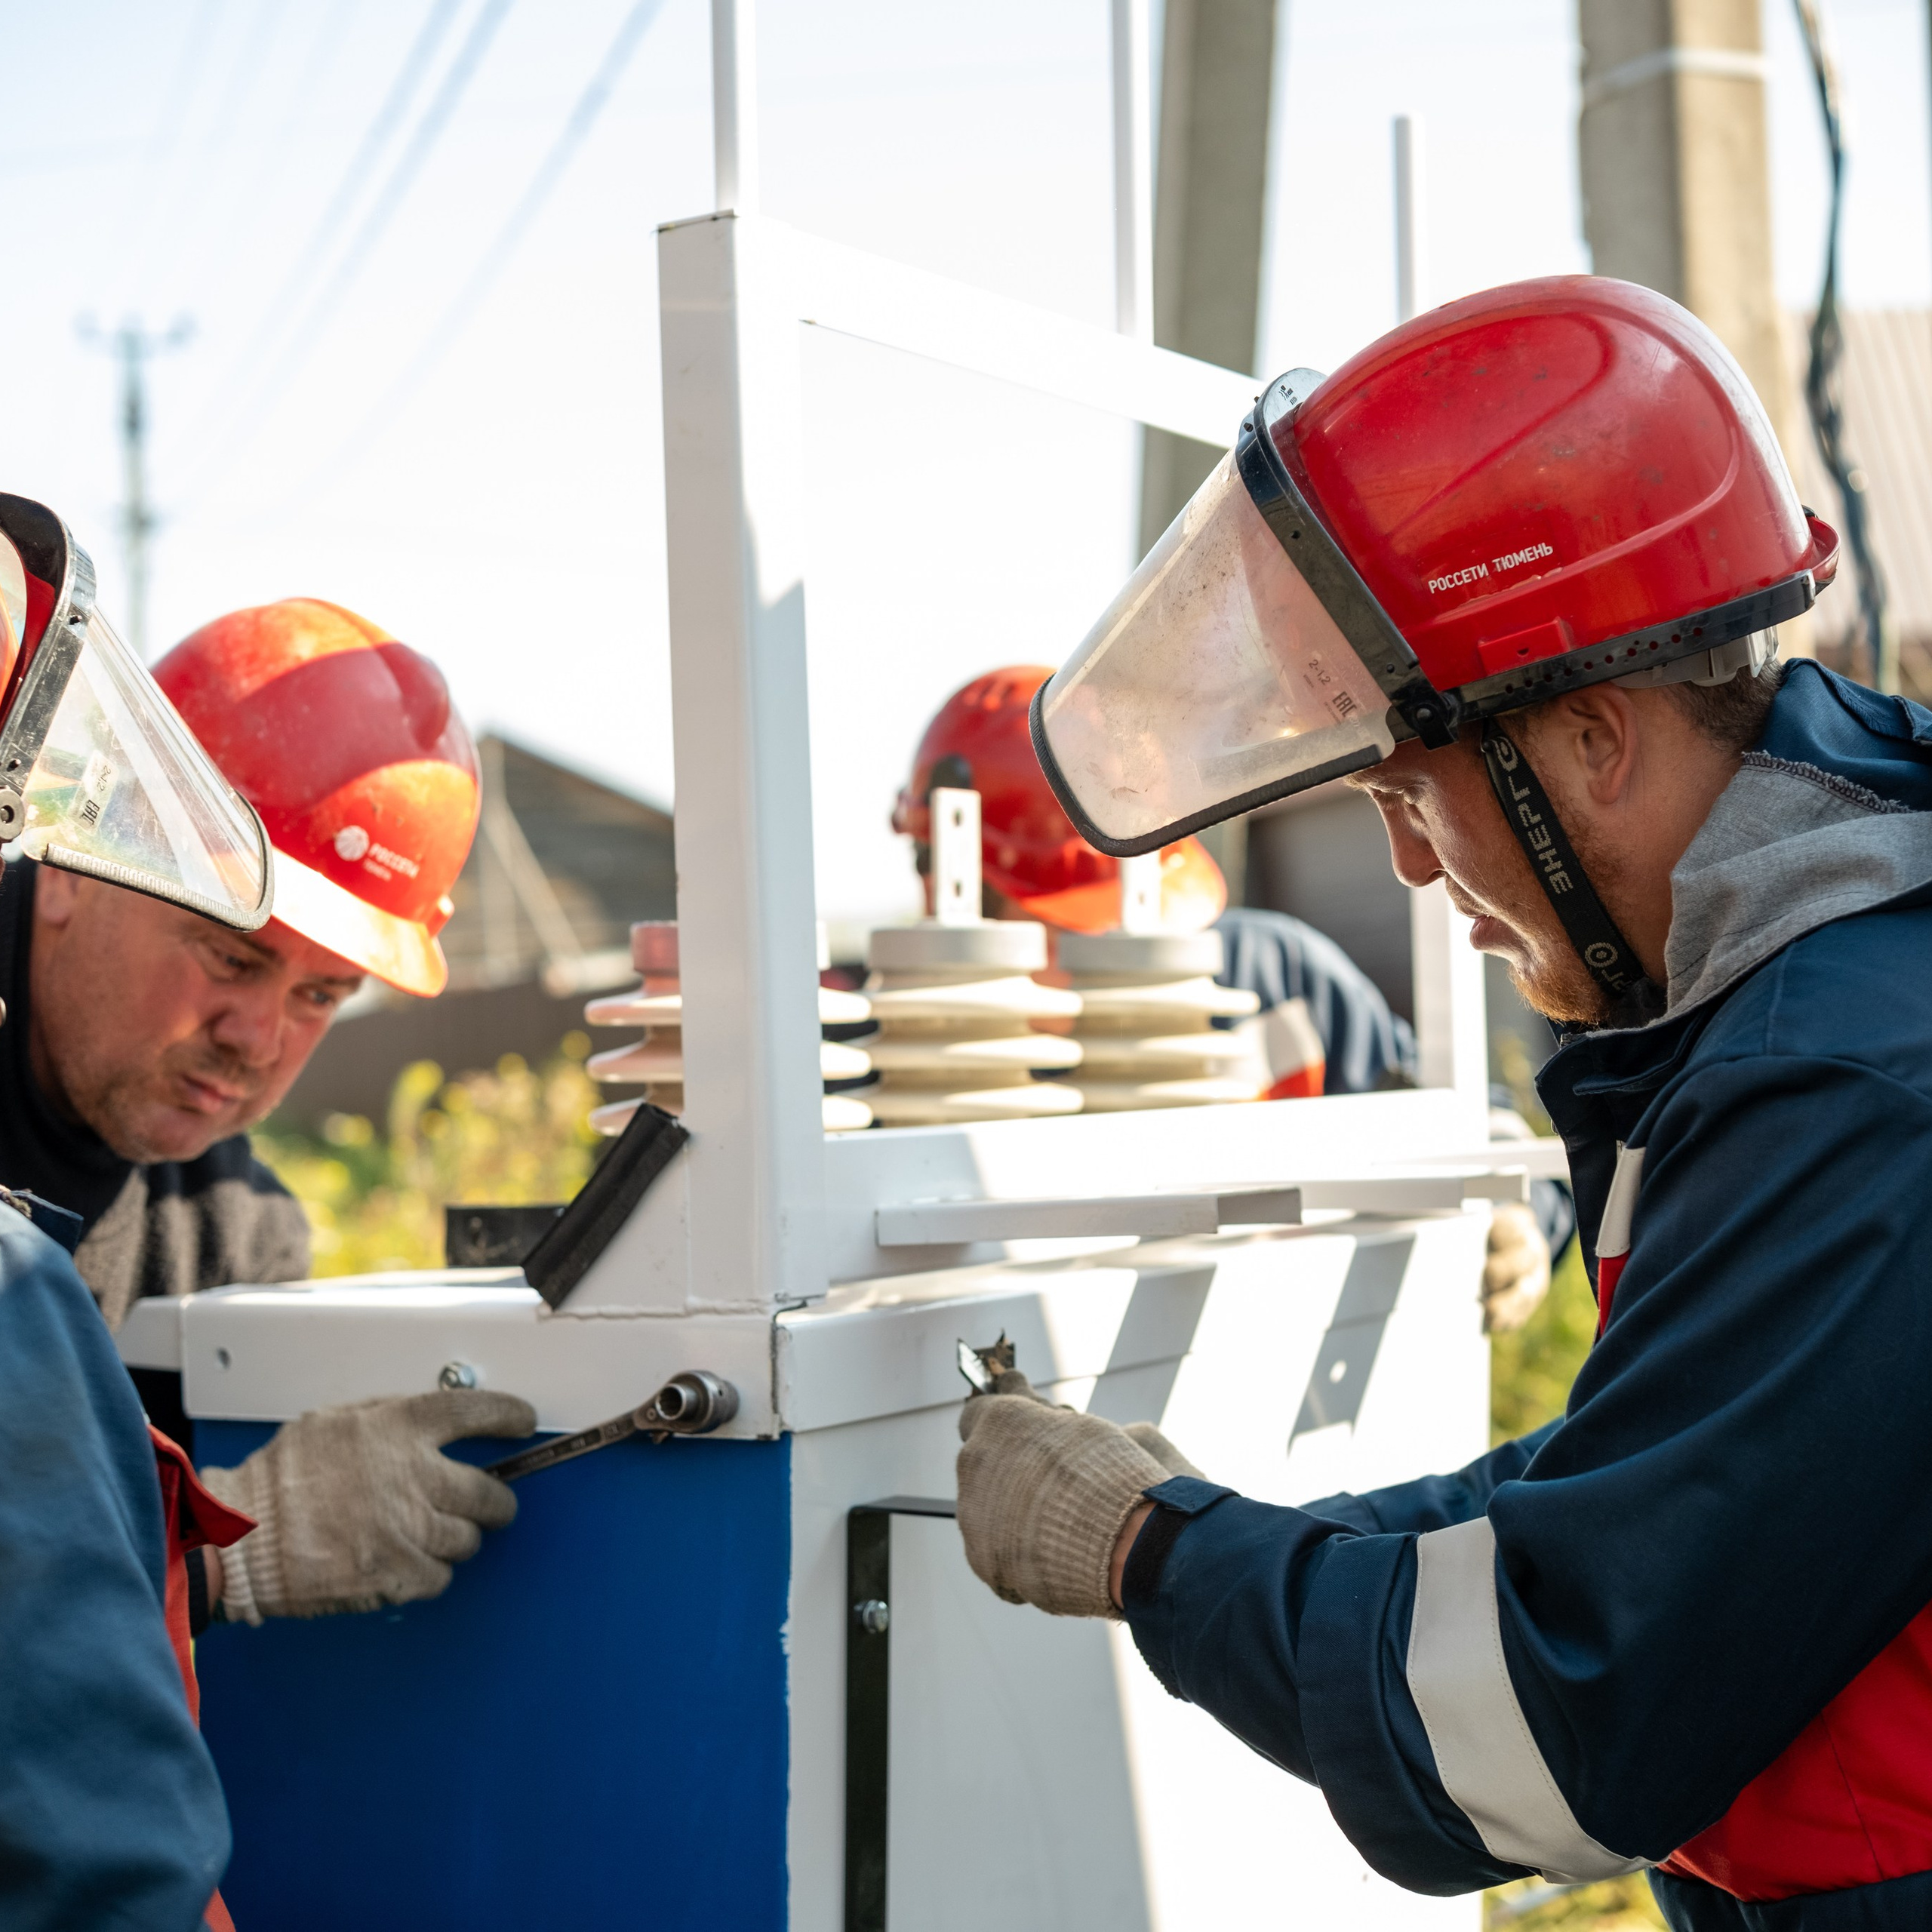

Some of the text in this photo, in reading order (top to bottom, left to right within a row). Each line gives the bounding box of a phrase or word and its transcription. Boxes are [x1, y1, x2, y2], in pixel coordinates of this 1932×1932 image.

[1428, 542, 1554, 594] РОССЕТИ ТЮМЕНЬ
[1494, 736, 1574, 895] ЭНЕРГО
